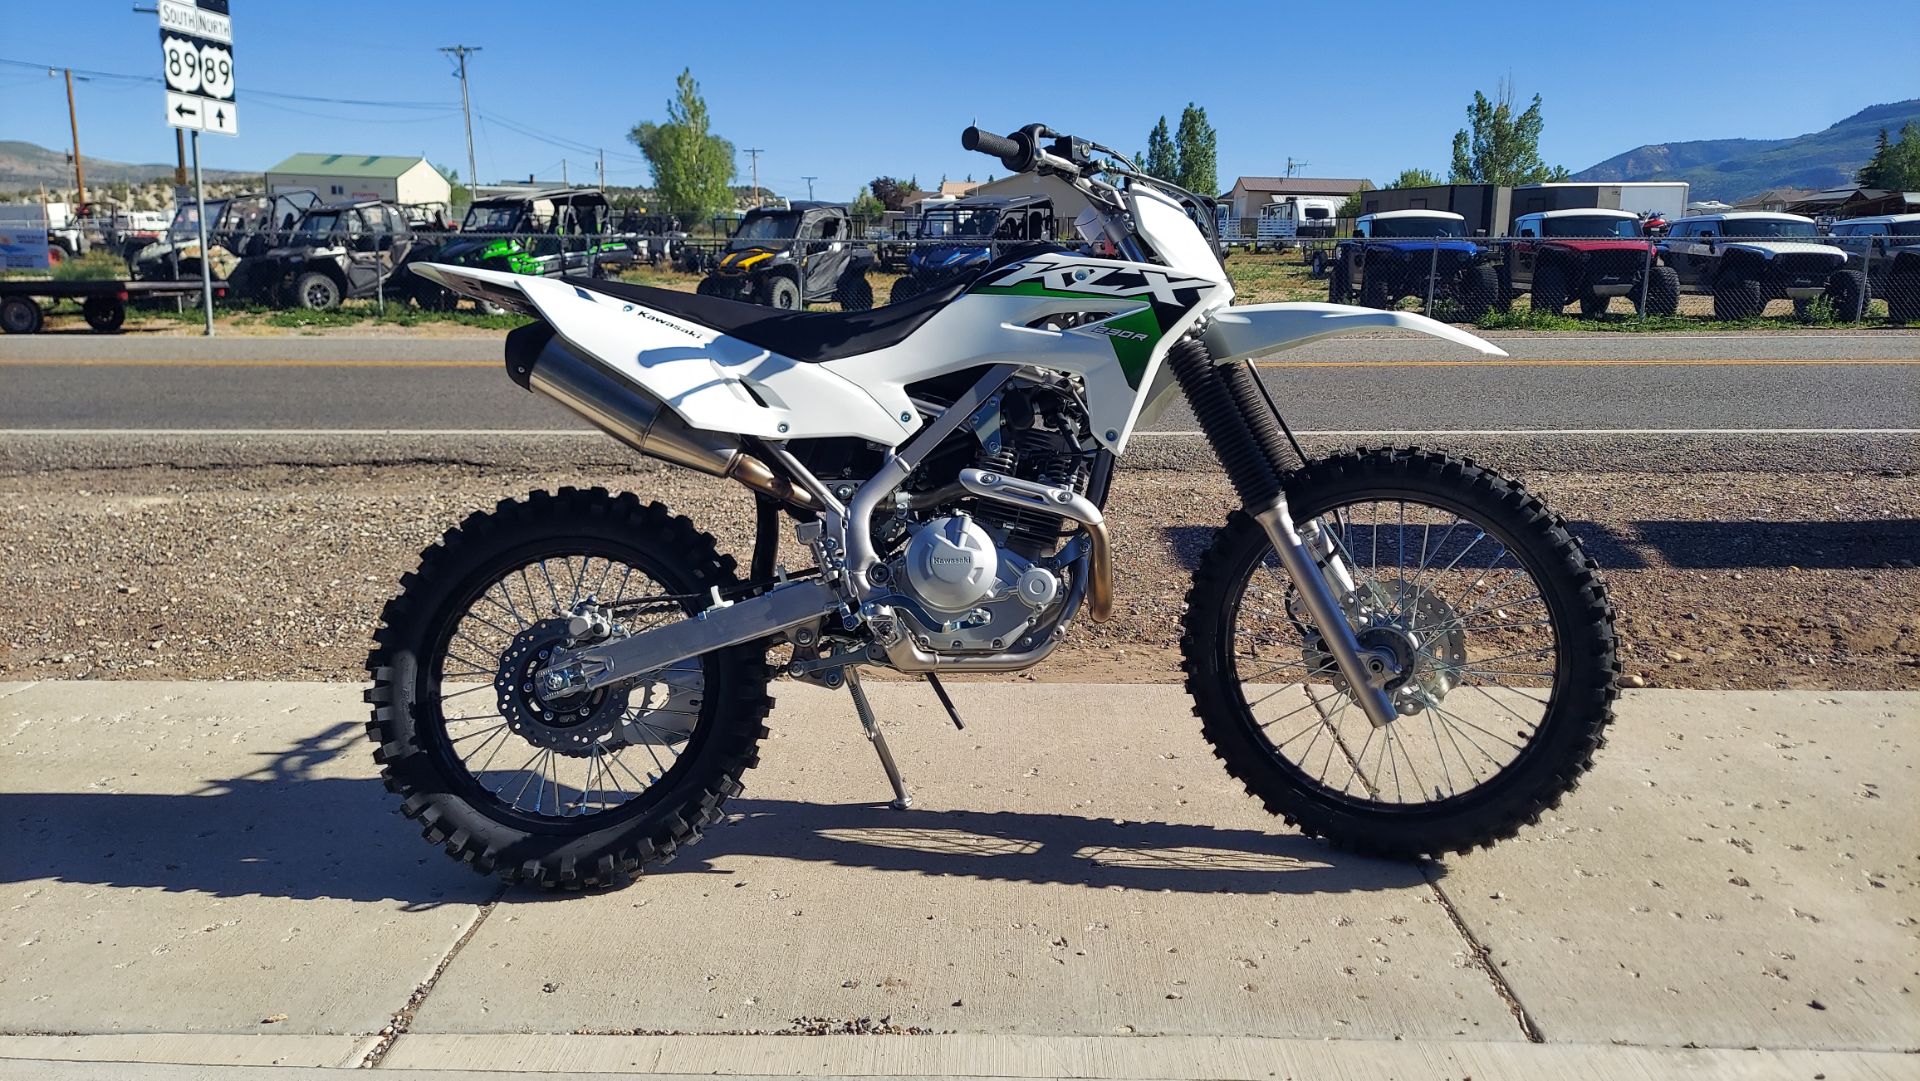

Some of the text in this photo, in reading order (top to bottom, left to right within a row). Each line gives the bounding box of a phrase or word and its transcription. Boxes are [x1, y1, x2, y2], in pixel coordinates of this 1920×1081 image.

[163, 4, 195, 27] SOUTH
[198, 15, 230, 35] NORTH
[169, 48, 196, 79] 89
[205, 57, 230, 86] 89
[637, 311, 703, 339] Kawasaki
[1091, 326, 1149, 342] 230R
[932, 556, 971, 565] Kawasaki
